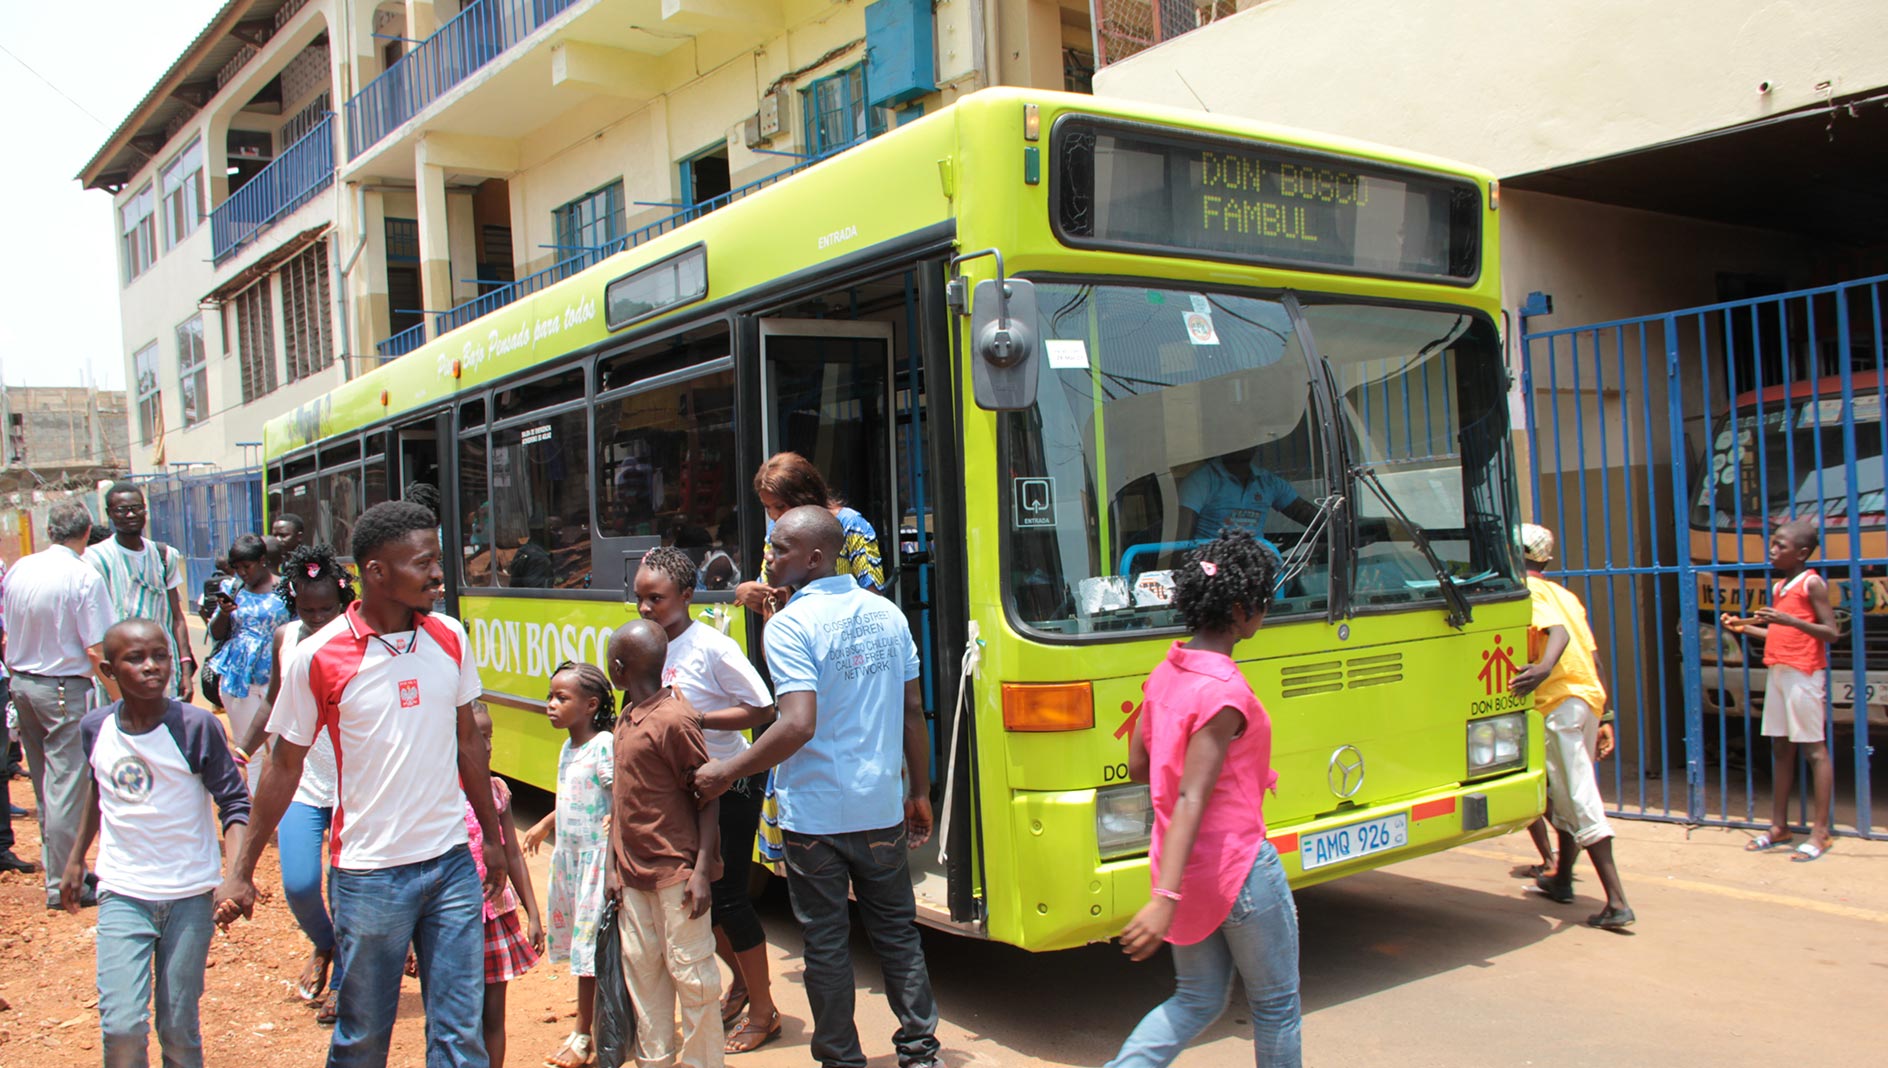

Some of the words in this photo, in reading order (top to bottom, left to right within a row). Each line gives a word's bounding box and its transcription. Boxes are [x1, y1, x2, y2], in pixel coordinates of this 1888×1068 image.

[1281, 163, 1368, 206] BOSCO
[1204, 195, 1317, 241] FAMBUL
[817, 224, 858, 250] ENTRADA
[532, 315, 561, 351] para
[564, 293, 596, 330] todos
[823, 617, 853, 633] COSER
[841, 622, 884, 641] CHDREN
[475, 618, 522, 675] DON
[845, 643, 865, 657] BSCO
[864, 649, 885, 663] FREE
[844, 660, 890, 681] NETWORK
[1471, 699, 1493, 715] DON
[1103, 762, 1129, 781] DO
[1316, 831, 1351, 863] AMQ
[1358, 822, 1390, 852] 926
